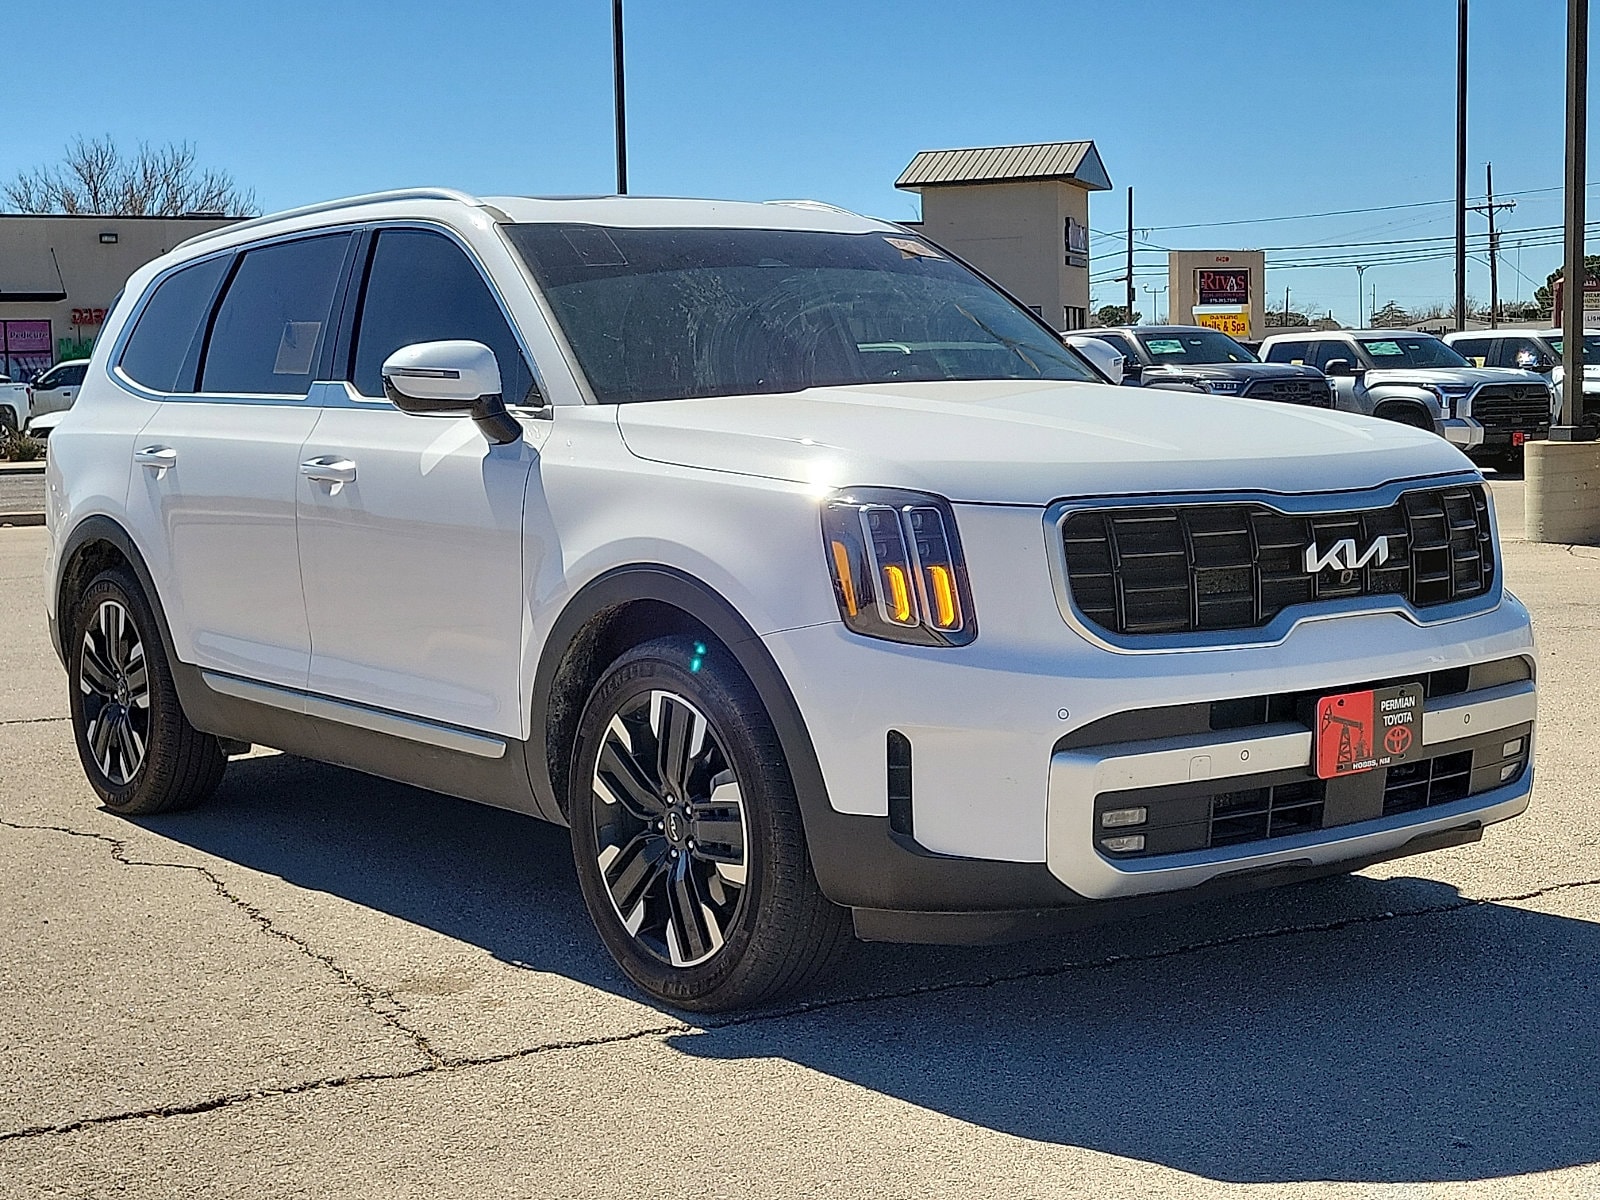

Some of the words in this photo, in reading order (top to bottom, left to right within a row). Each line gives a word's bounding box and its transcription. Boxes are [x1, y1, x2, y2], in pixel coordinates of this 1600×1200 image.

[1203, 272, 1245, 292] RIVAS
[1223, 320, 1229, 332] &
[1232, 320, 1245, 334] Spa
[1306, 535, 1389, 573] KIA
[1380, 696, 1415, 711] PERMIAN
[1383, 712, 1412, 726] TOYOTA
